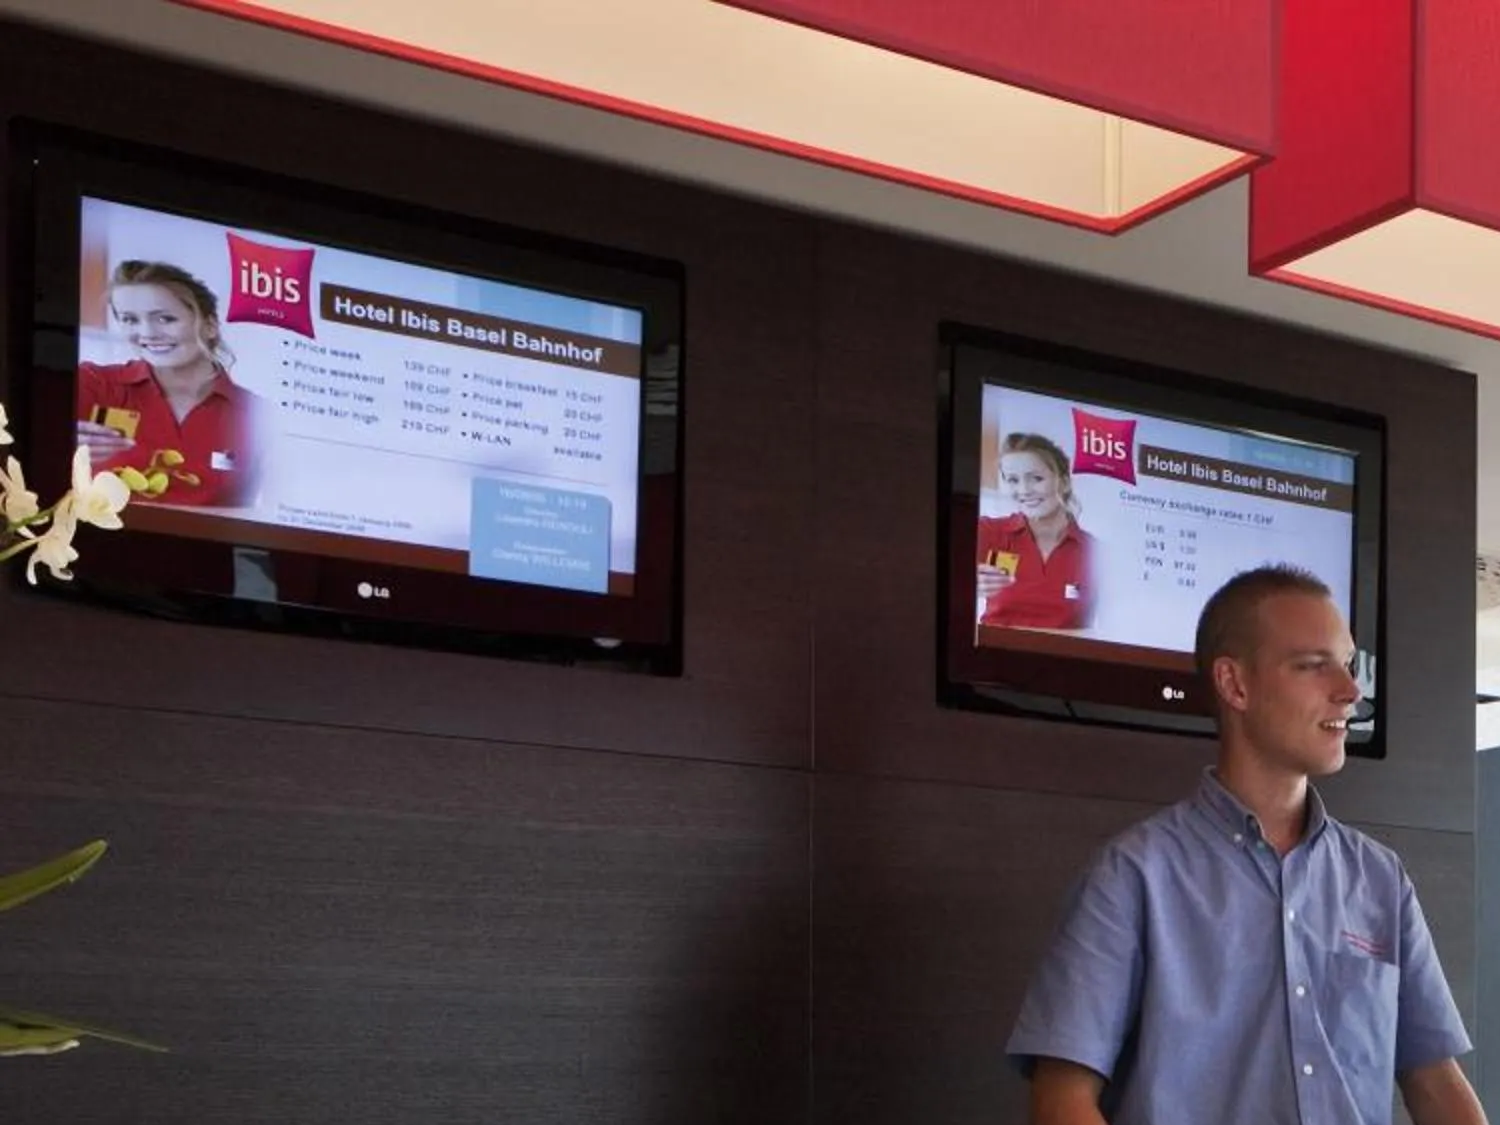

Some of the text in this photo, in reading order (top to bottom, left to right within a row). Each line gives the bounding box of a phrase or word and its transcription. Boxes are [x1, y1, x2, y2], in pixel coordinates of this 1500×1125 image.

[241, 260, 301, 303] ibis
[335, 296, 603, 363] Hotel Ibis Basel Bahnhof
[471, 431, 511, 446] W-LAN
[1082, 428, 1126, 460] ibis
[1147, 454, 1327, 501] Hotel Ibis Basel Bahnhof
[374, 587, 390, 598] LG
